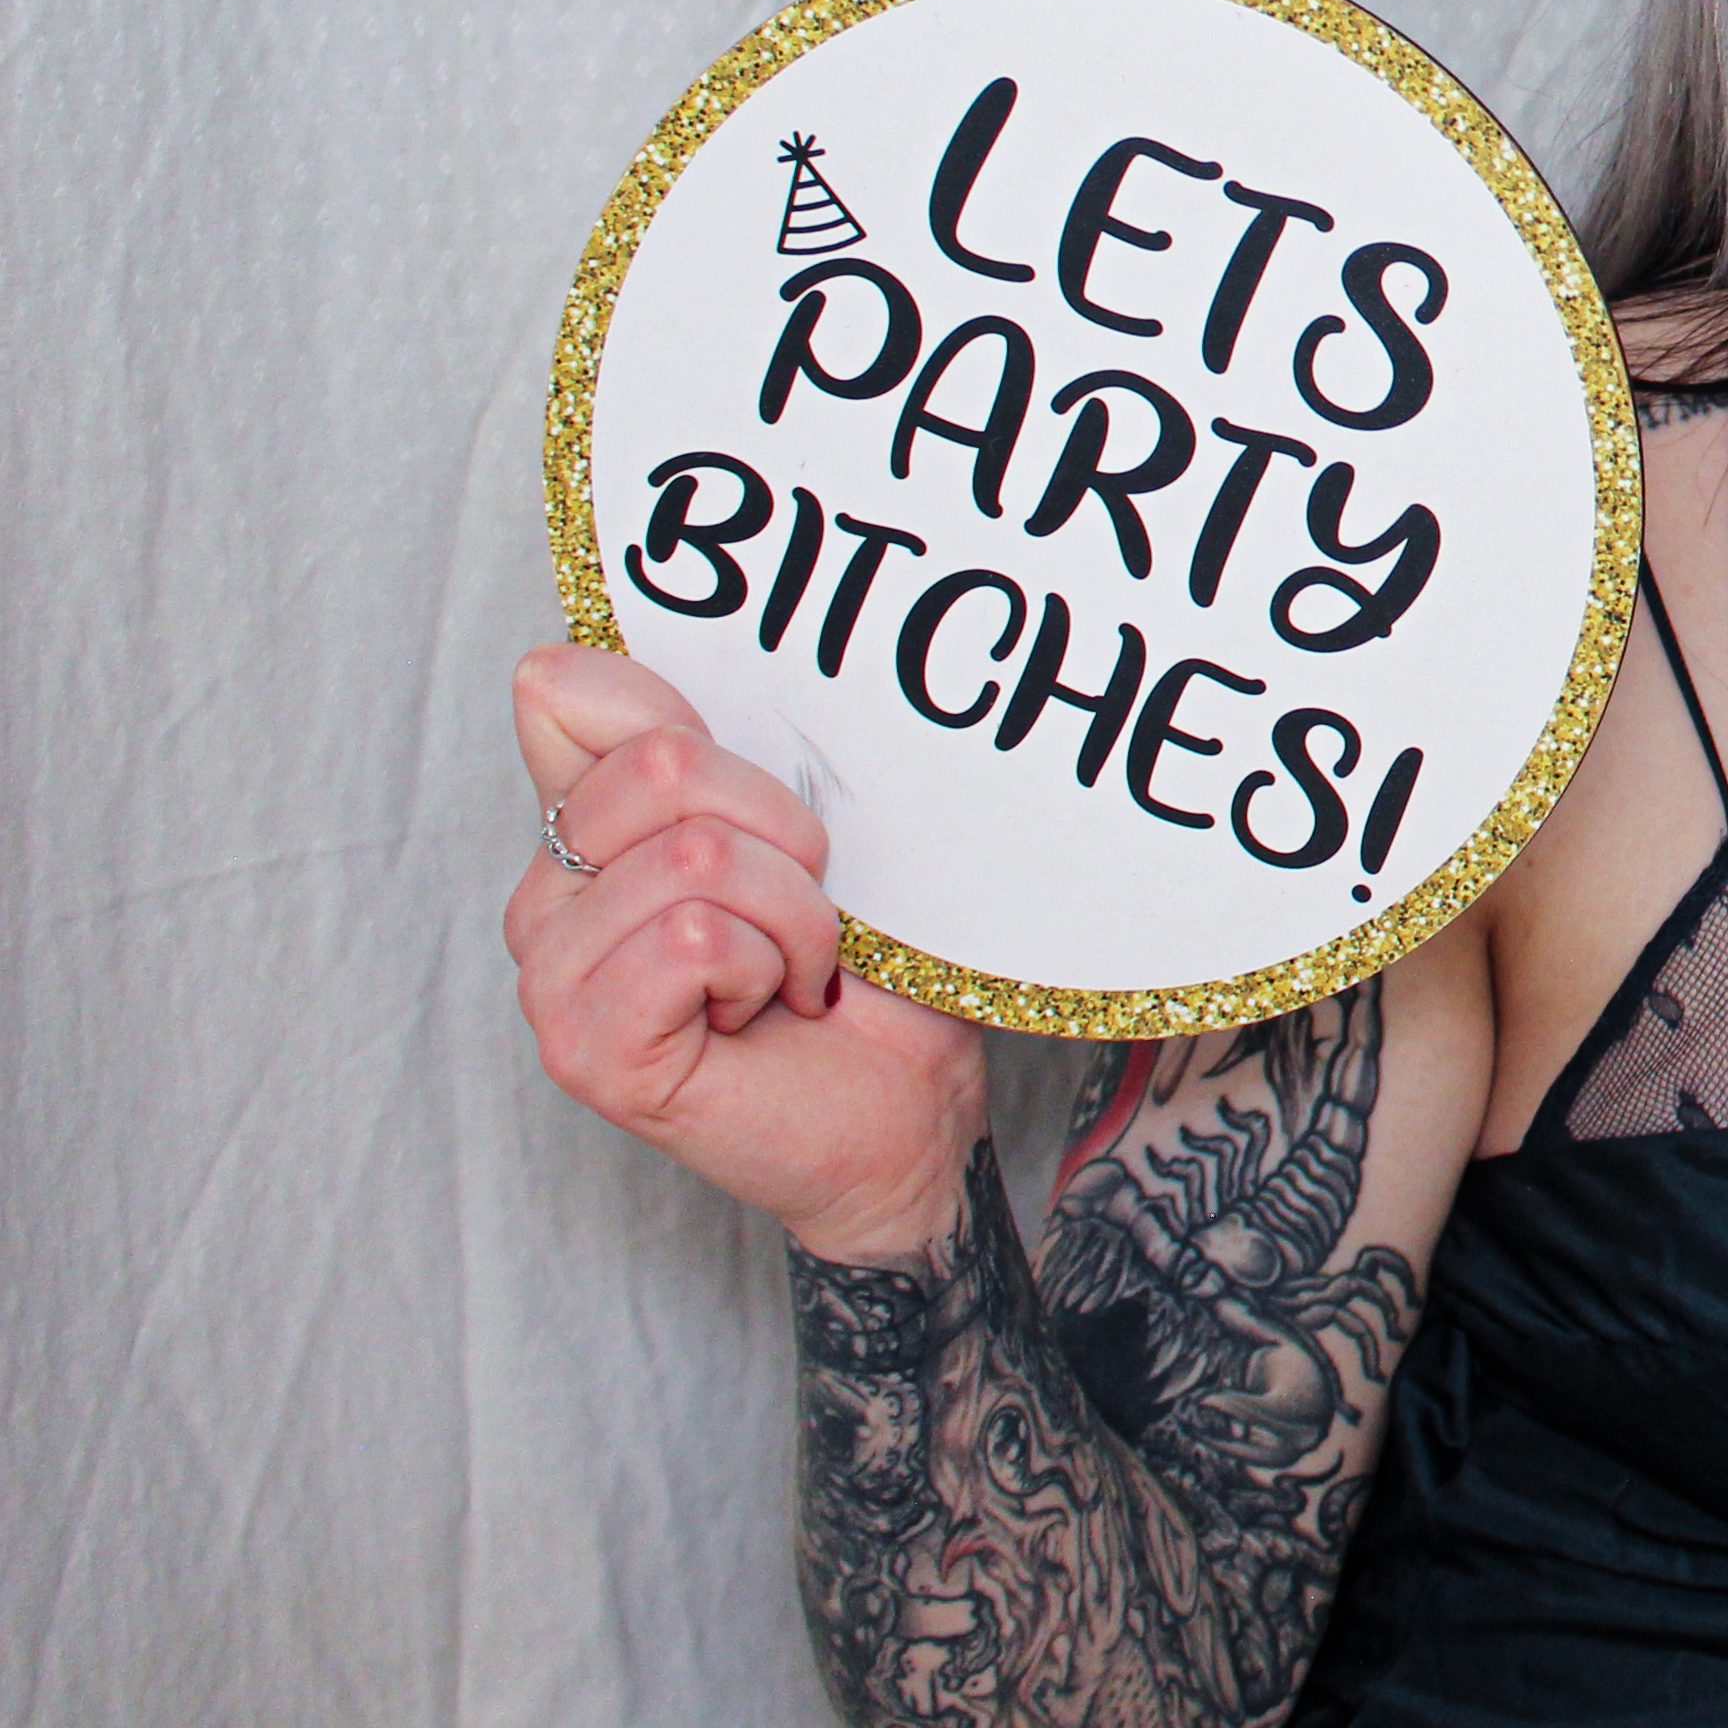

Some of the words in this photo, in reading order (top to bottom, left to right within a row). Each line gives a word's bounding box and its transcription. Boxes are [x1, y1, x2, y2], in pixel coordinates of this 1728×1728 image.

[928, 77, 1448, 431] LETS
[759, 258, 1441, 653] PARTY
[624, 452, 1423, 902] BITCHES!
